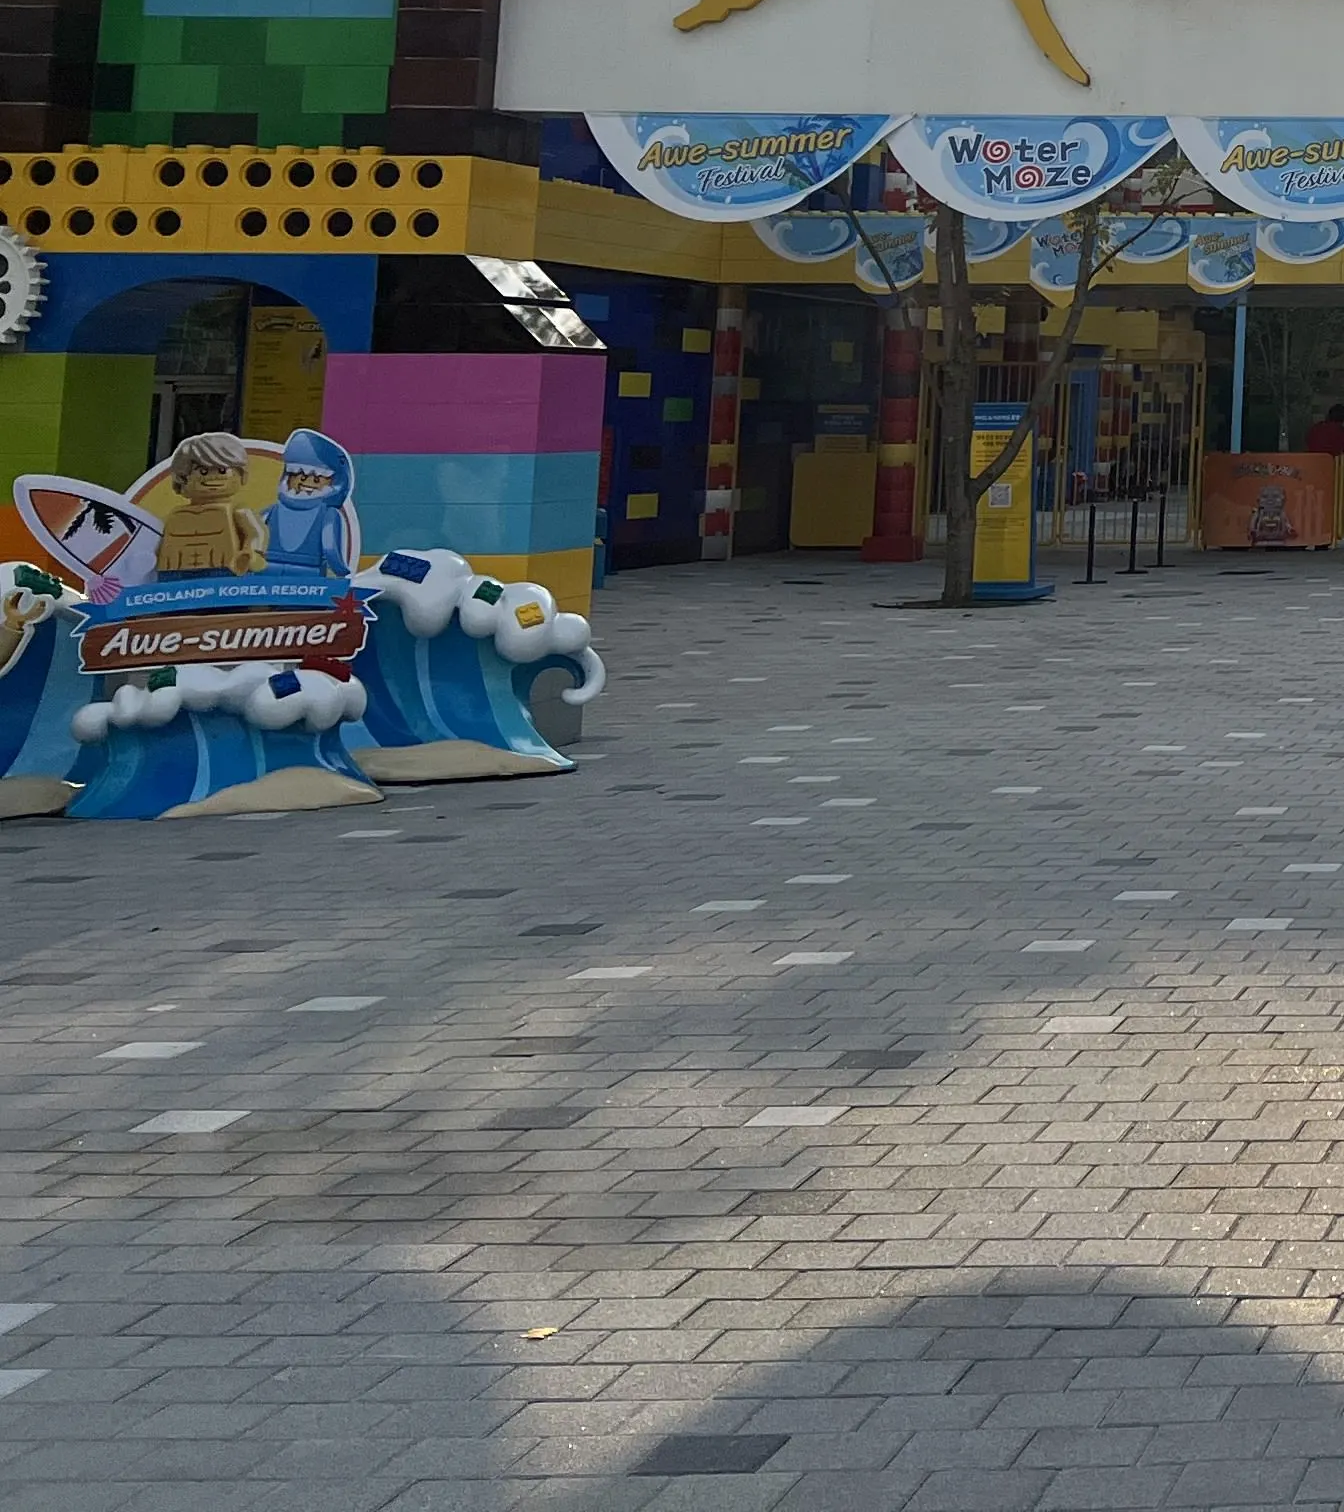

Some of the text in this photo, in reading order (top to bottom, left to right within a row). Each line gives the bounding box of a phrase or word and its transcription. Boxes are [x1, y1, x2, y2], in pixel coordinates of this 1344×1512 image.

[638, 125, 850, 171] Awe-summer
[949, 133, 1079, 165] Water
[697, 161, 785, 192] Festival
[985, 161, 1091, 193] Maze
[219, 585, 268, 597] KOREA
[271, 585, 328, 597] RESORT
[100, 621, 347, 656] Awe-summer
